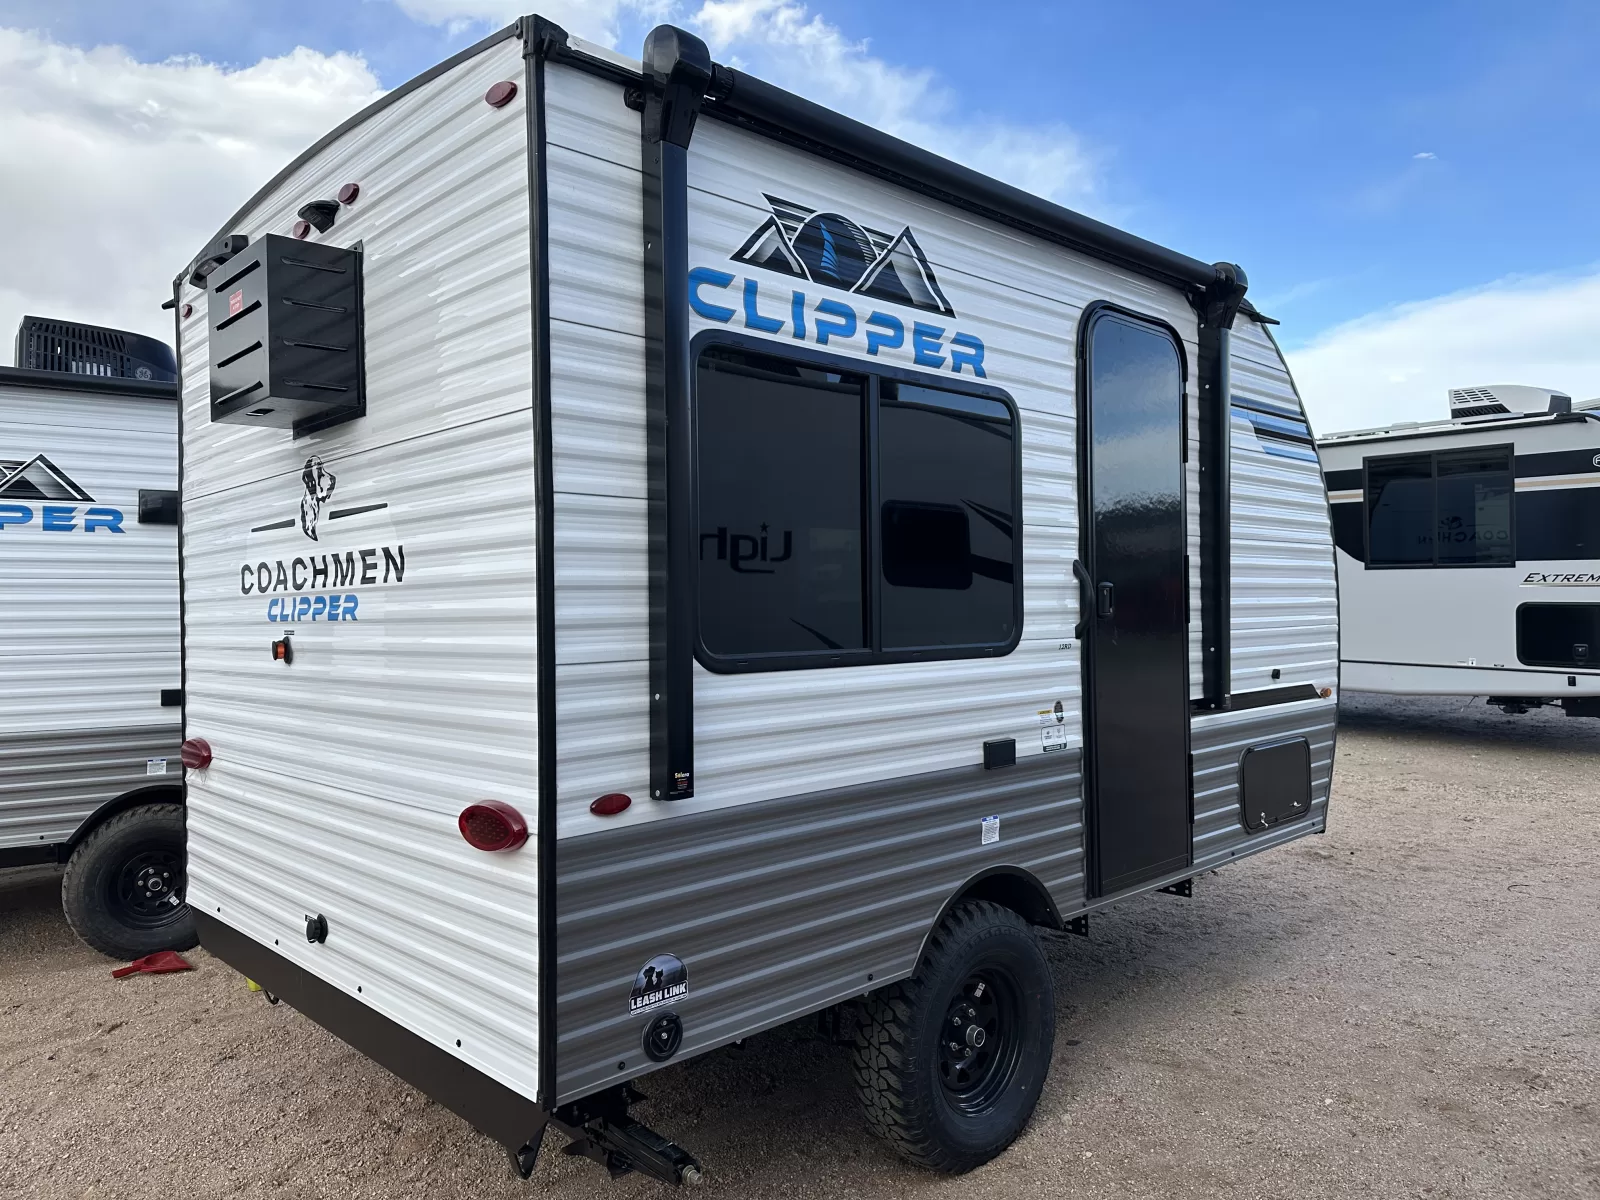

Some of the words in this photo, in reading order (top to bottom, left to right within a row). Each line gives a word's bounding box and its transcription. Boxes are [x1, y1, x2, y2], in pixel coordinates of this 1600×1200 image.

[688, 266, 987, 379] CLIPPER
[241, 545, 405, 595] COACHMEN
[267, 594, 359, 622] CLIPPER
[631, 990, 663, 1010] LEASH
[664, 982, 687, 999] LINK
